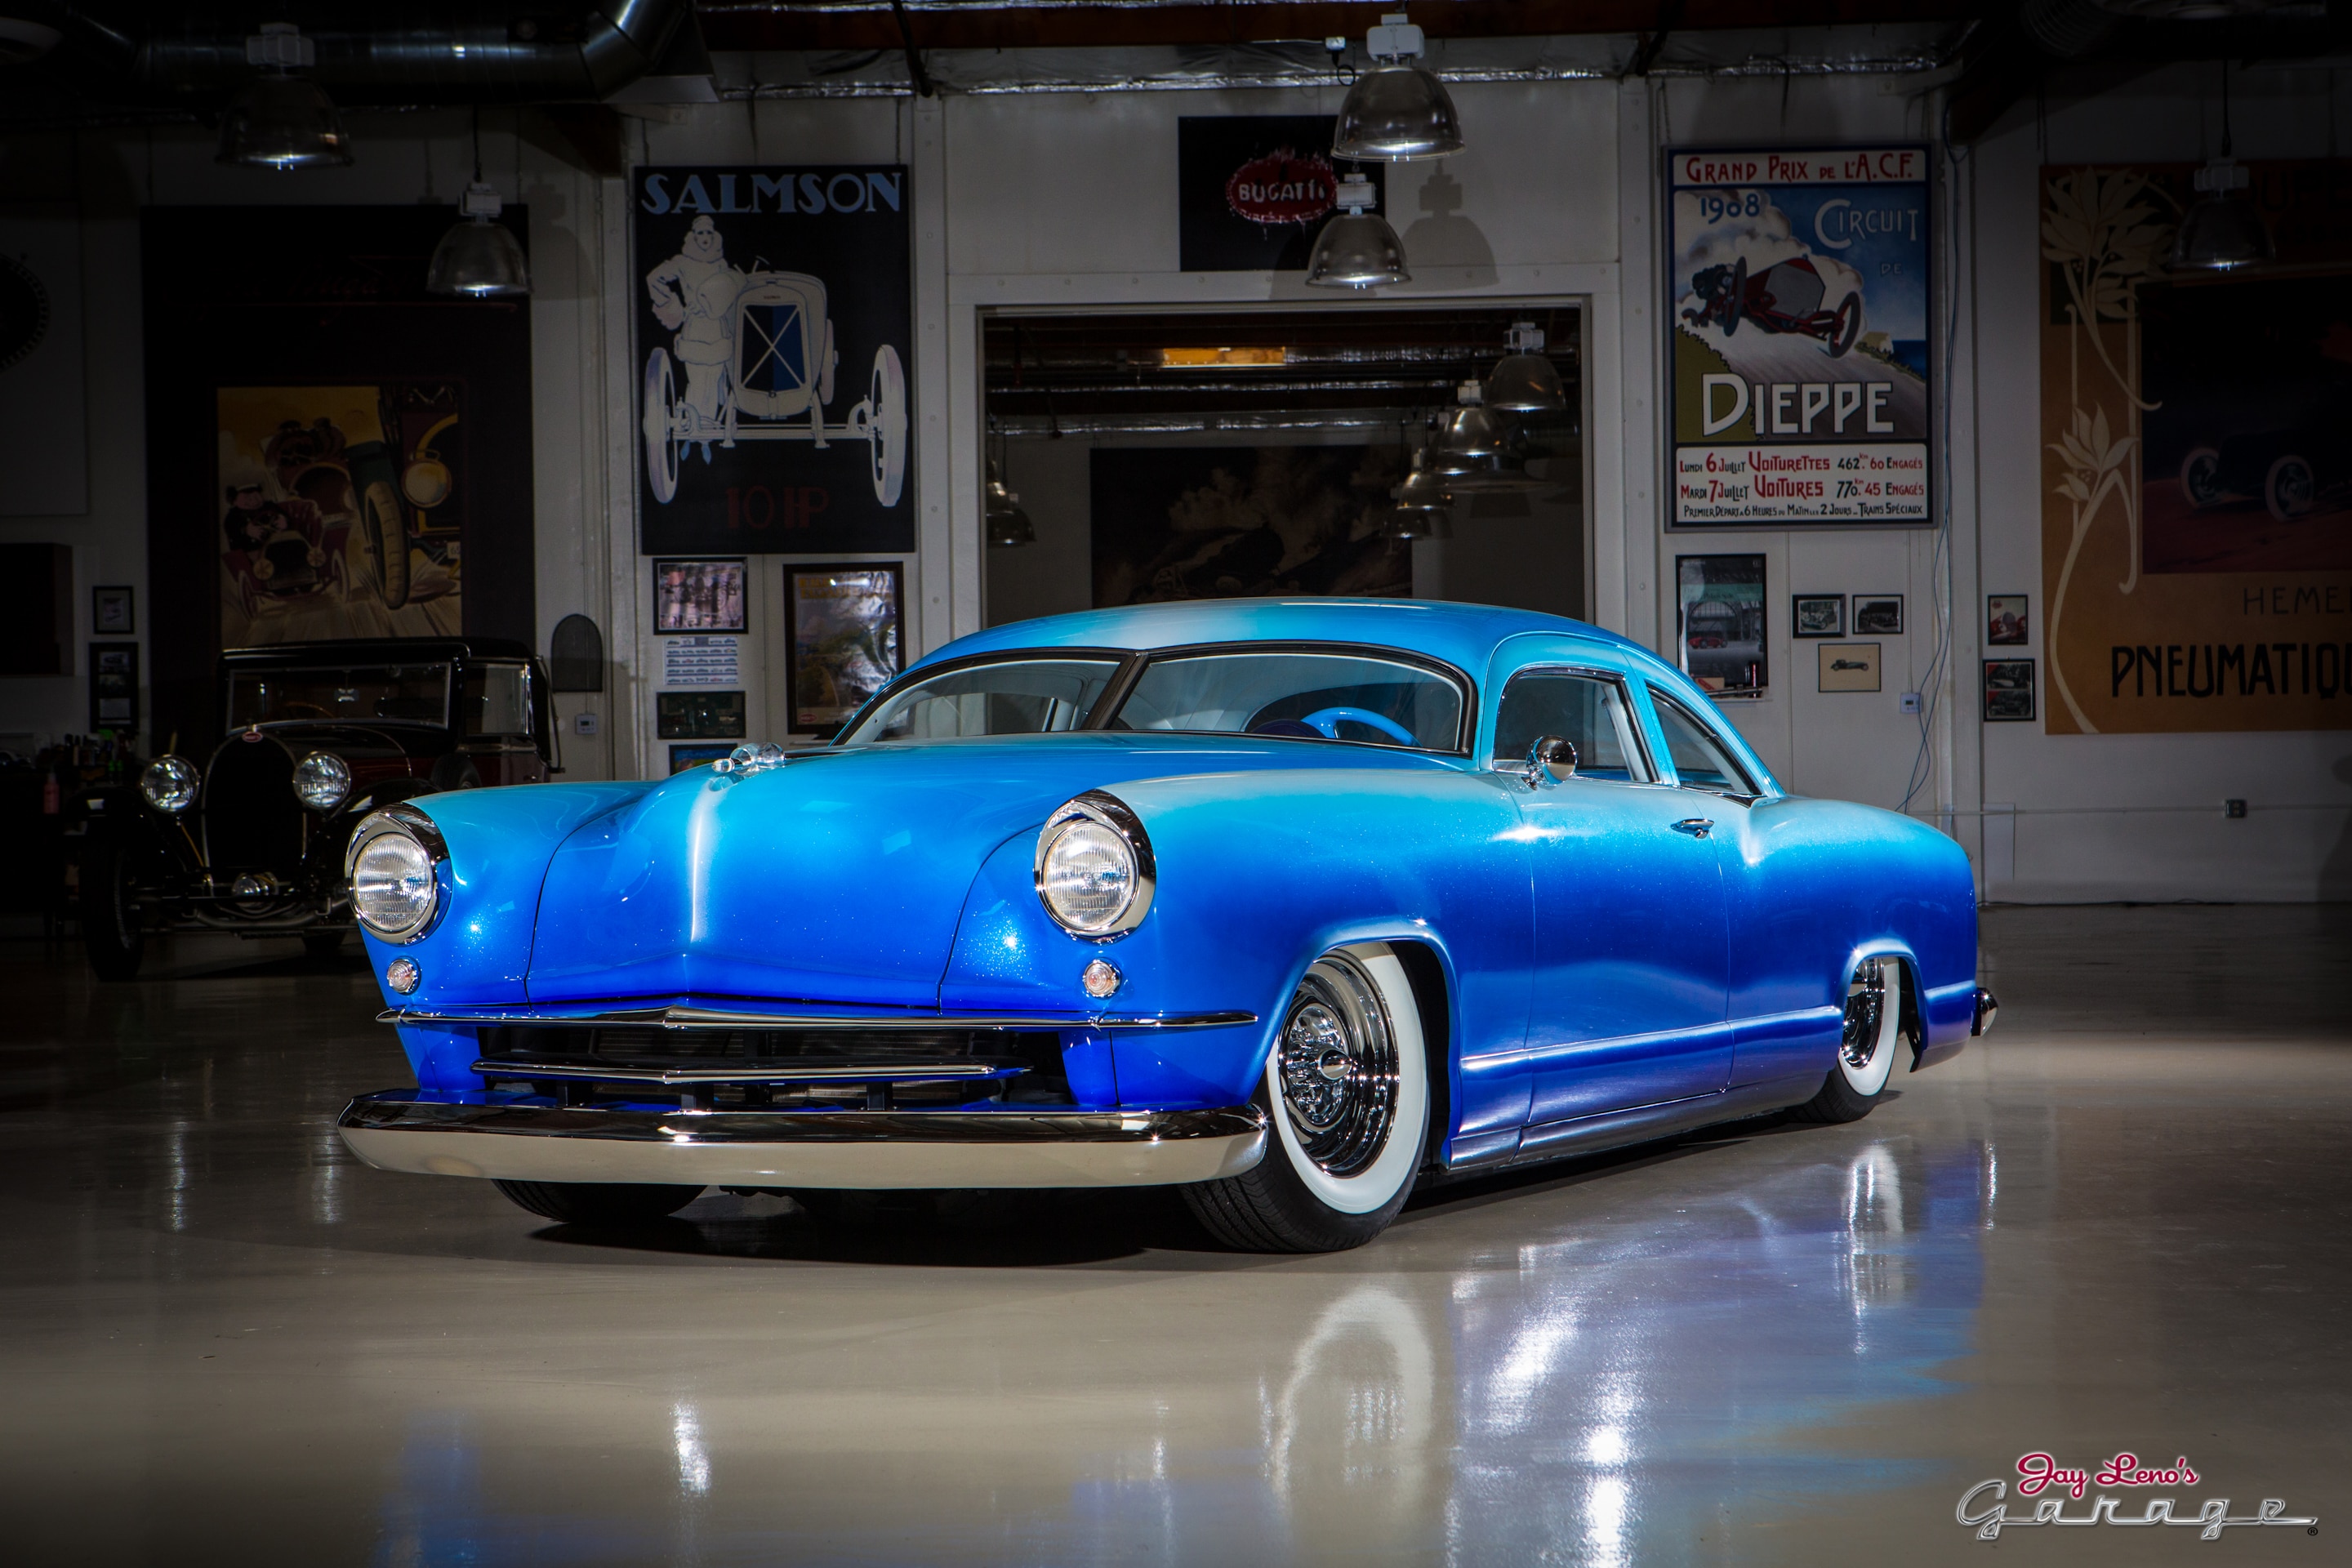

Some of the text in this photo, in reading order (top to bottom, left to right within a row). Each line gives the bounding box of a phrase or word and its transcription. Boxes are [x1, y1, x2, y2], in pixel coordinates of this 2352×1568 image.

[1686, 157, 1757, 183] GRAND
[1769, 155, 1808, 182] PRIX
[1820, 167, 1835, 179] DE
[640, 172, 902, 215] SALMSON
[1238, 178, 1325, 203] BUGATTI
[1701, 194, 1759, 224] 1908
[1814, 198, 1918, 250] CIRCUIT
[1881, 264, 1901, 275] DE
[1701, 373, 1895, 437] DIEPPE
[1680, 461, 1703, 473] LUNDI
[1706, 452, 1717, 473] 6
[1718, 458, 1746, 474] JUILLET
[1748, 451, 1829, 473] VOITURETTES
[1870, 457, 1884, 470] 60
[1681, 484, 1707, 499] MARDI
[1708, 480, 1718, 502] 7
[1718, 483, 1749, 501] JUILLET
[1754, 474, 1823, 500] VOITURES
[1864, 483, 1881, 496] 45
[726, 484, 830, 530] 10 HP
[1684, 505, 1715, 517] PREMIER
[1744, 507, 1751, 516] 6
[1753, 506, 1777, 517] HEURES
[1788, 504, 1809, 516] MATIN
[1820, 504, 1827, 515] 2
[1829, 503, 1851, 516] JOURS
[1857, 502, 1884, 517] TRAINS
[2244, 586, 2352, 615] HEME
